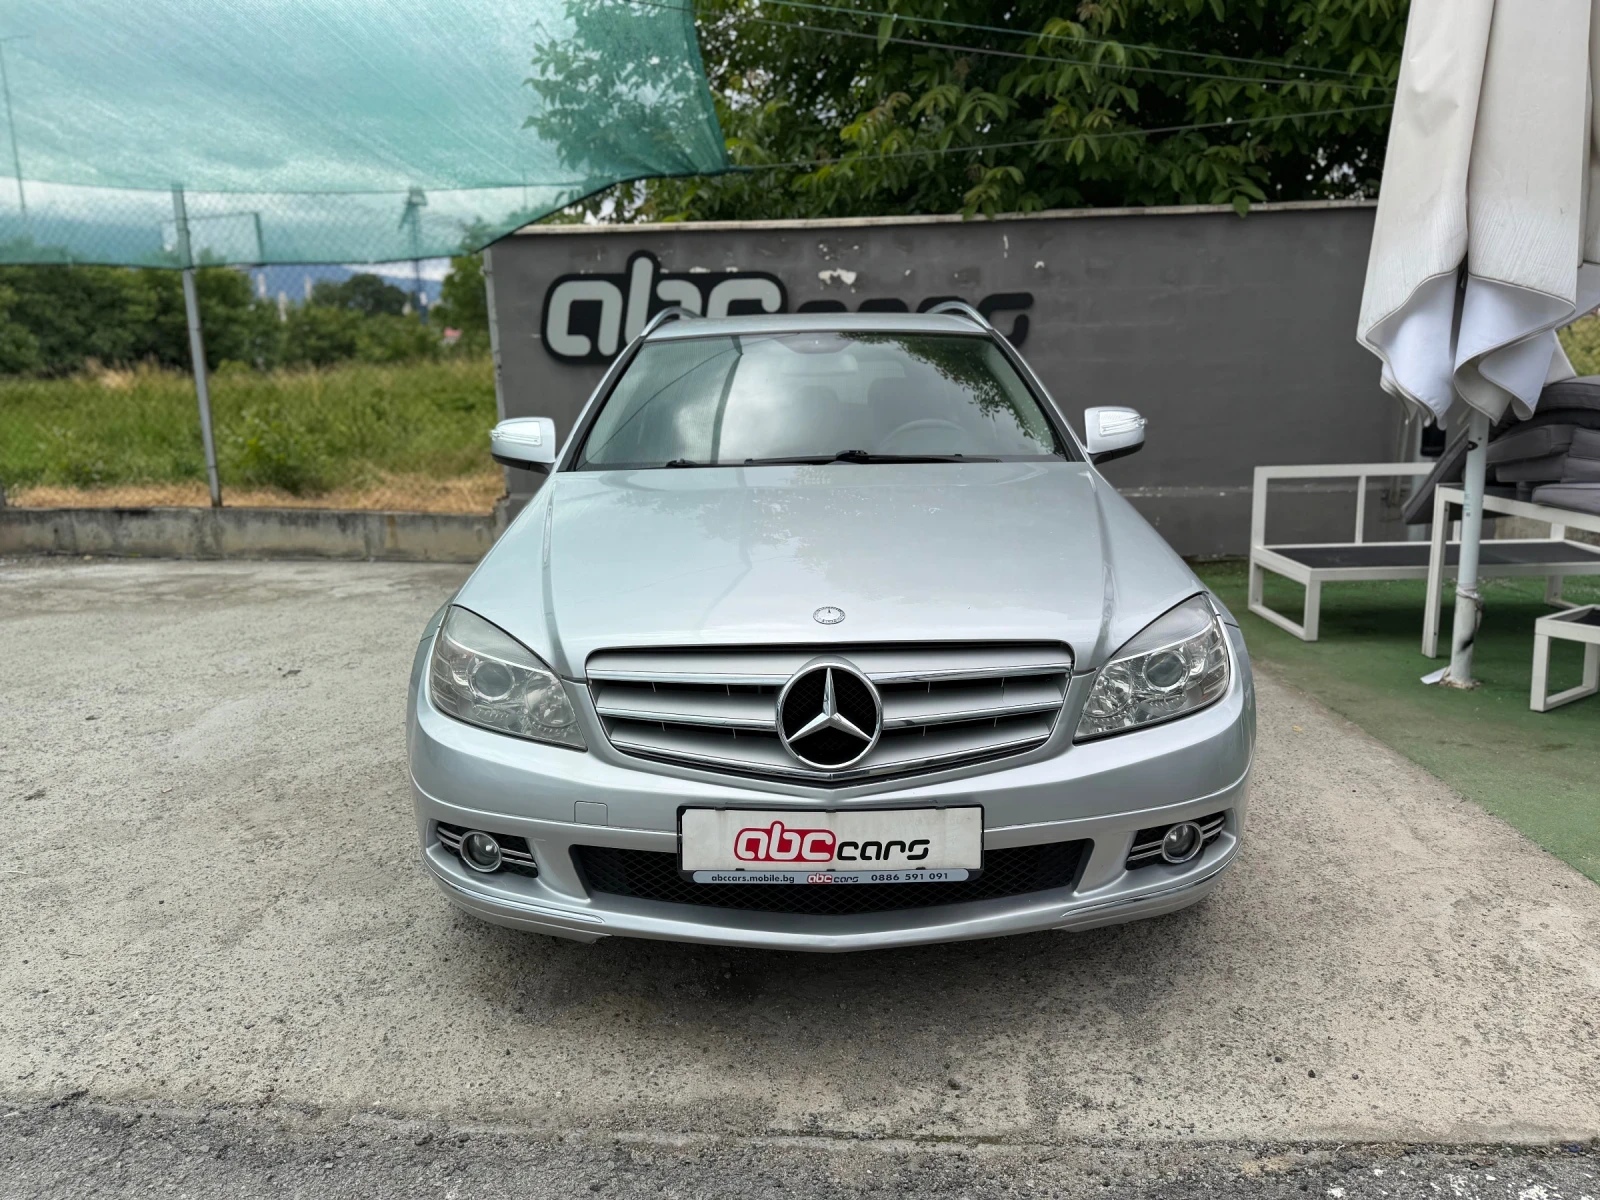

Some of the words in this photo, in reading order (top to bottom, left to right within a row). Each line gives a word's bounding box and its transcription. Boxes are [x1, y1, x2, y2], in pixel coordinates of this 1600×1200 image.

[736, 821, 834, 861] abc
[836, 839, 931, 861] cars
[711, 874, 795, 884] abccars.mobile.bg
[806, 873, 833, 884] abc
[870, 874, 900, 882] 0886
[904, 873, 925, 881] 591
[928, 872, 949, 880] 091
